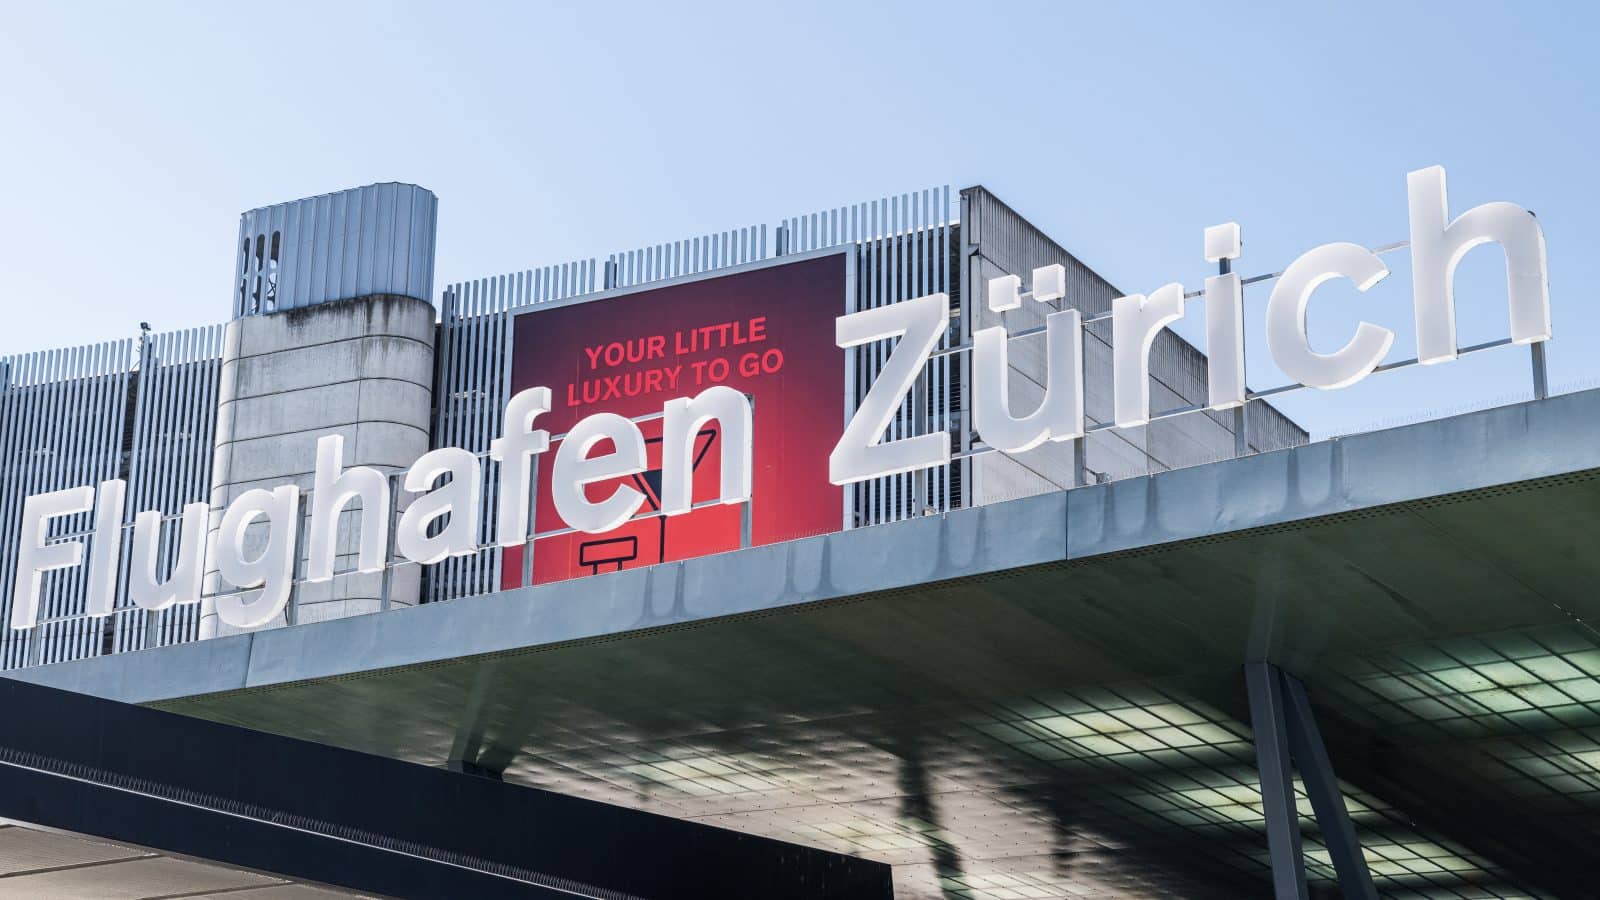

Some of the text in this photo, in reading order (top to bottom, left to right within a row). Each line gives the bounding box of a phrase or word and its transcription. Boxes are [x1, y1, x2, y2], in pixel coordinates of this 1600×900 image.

[585, 316, 767, 370] YOUR LITTLE
[10, 165, 1551, 630] Flughafen Zürich
[567, 348, 784, 407] LUXURY TO GO
